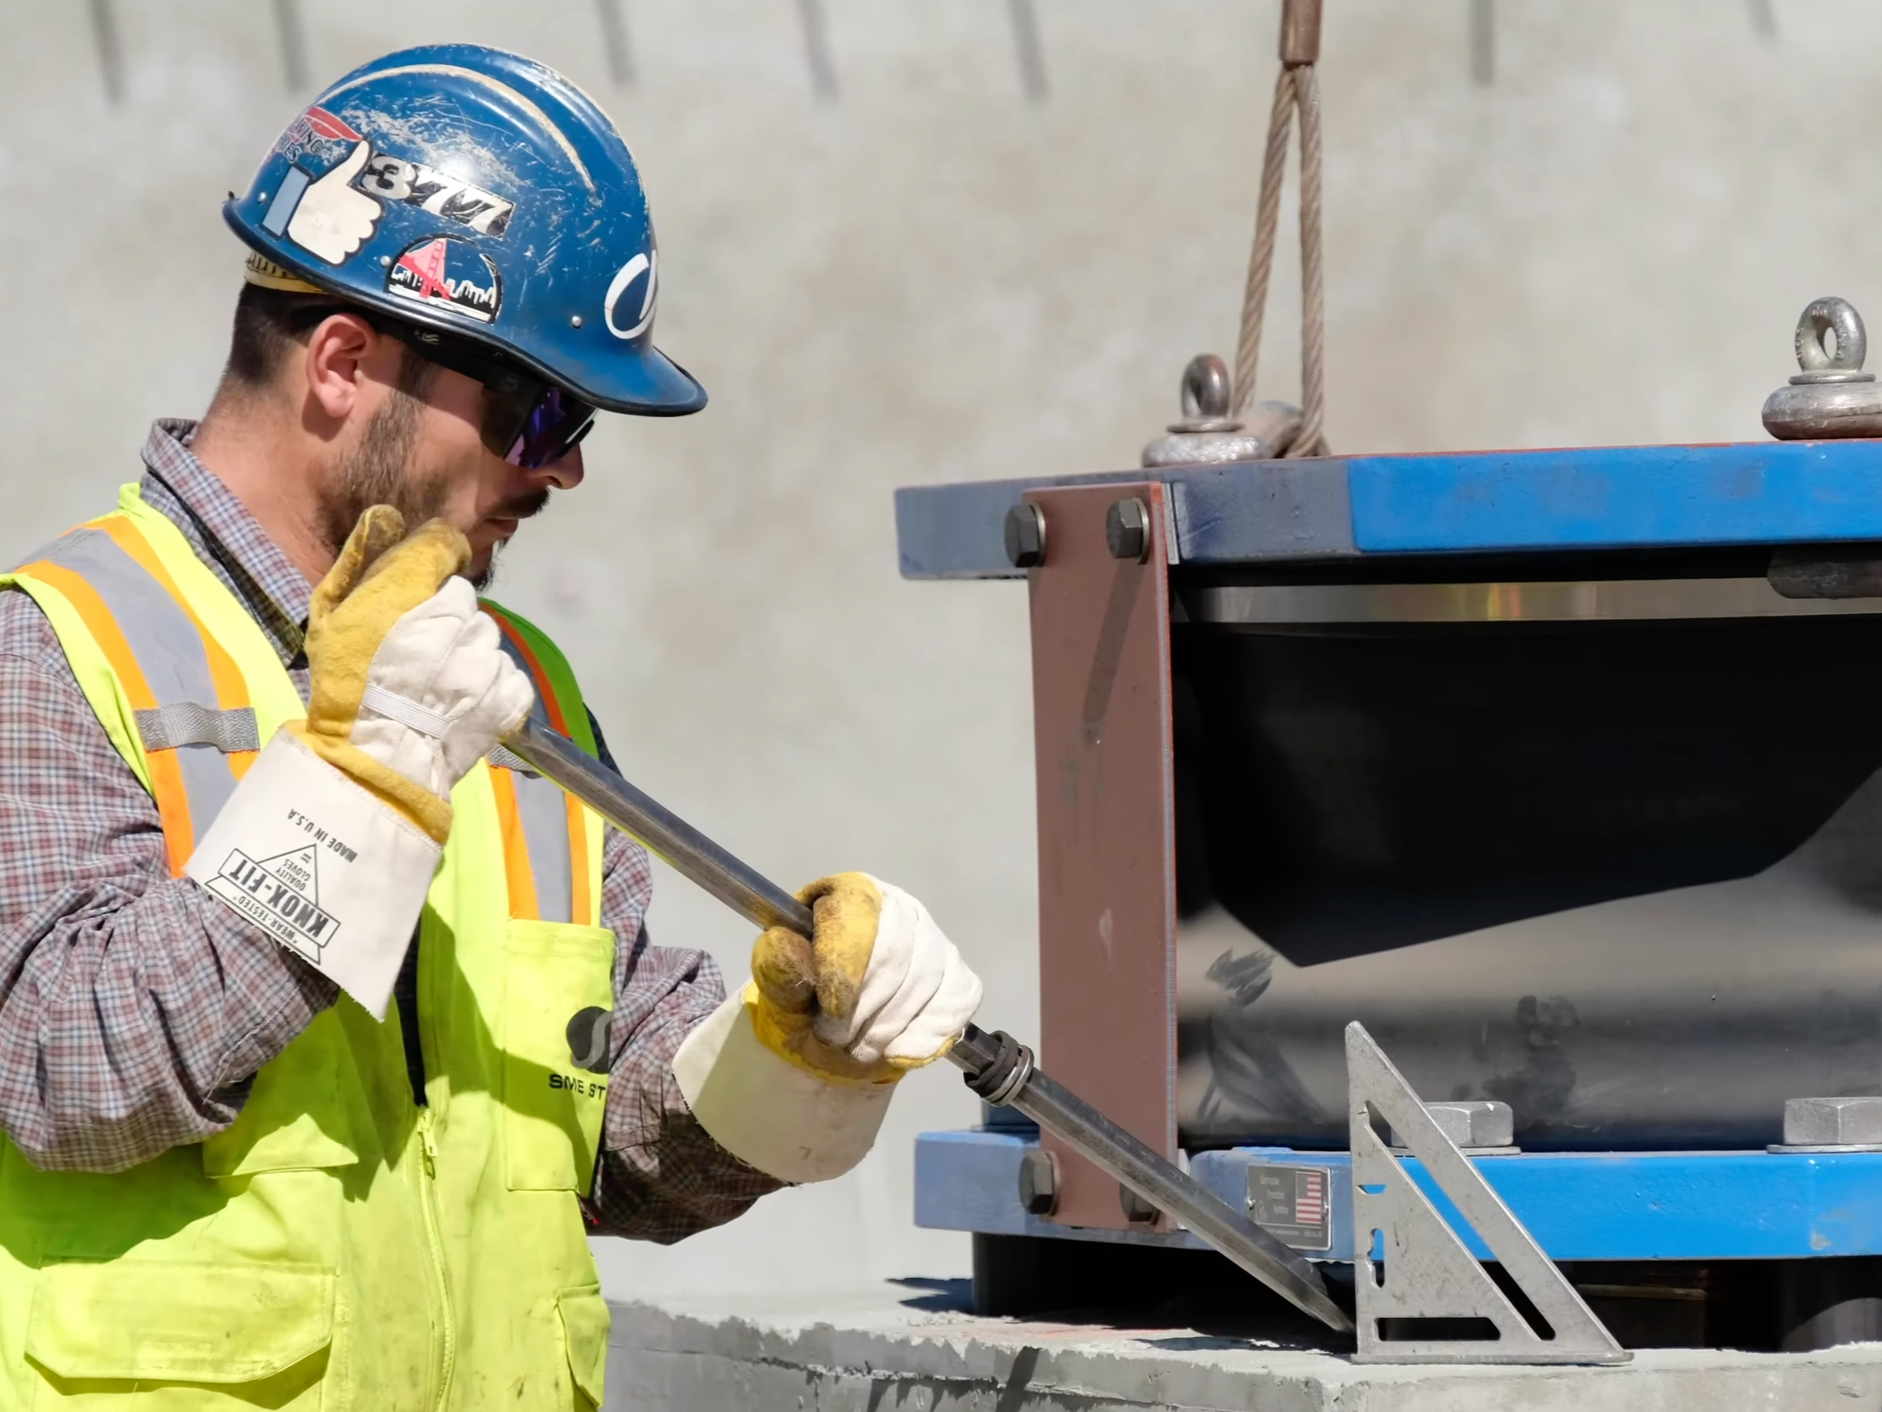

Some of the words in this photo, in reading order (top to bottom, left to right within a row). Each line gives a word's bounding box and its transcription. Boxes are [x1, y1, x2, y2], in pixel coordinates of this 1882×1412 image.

[313, 828, 329, 843] IN
[326, 837, 358, 863] MADE
[275, 867, 307, 892] QUALITY
[282, 858, 312, 882] GLOVES
[228, 859, 329, 939] KNOX-FIT
[549, 1074, 585, 1094] SME
[588, 1083, 607, 1100] ST
